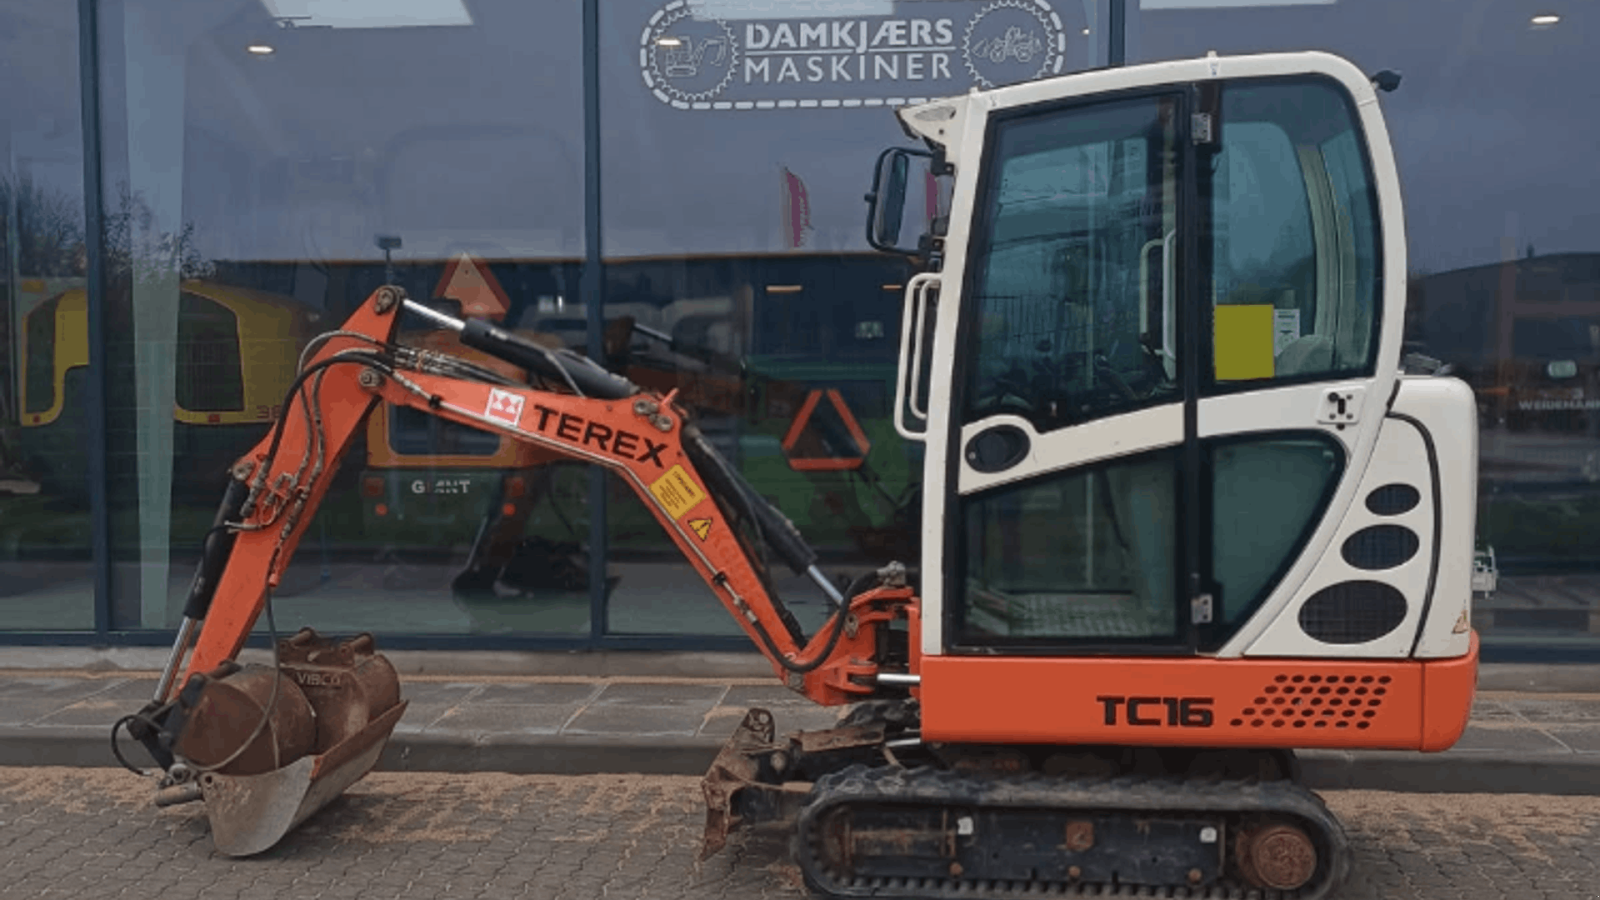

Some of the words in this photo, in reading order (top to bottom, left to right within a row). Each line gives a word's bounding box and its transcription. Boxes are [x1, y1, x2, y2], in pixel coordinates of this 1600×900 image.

[746, 19, 953, 53] DAMKJÆRS
[744, 53, 951, 83] MASKINER
[533, 404, 668, 469] TEREX
[1096, 695, 1214, 727] TC16
